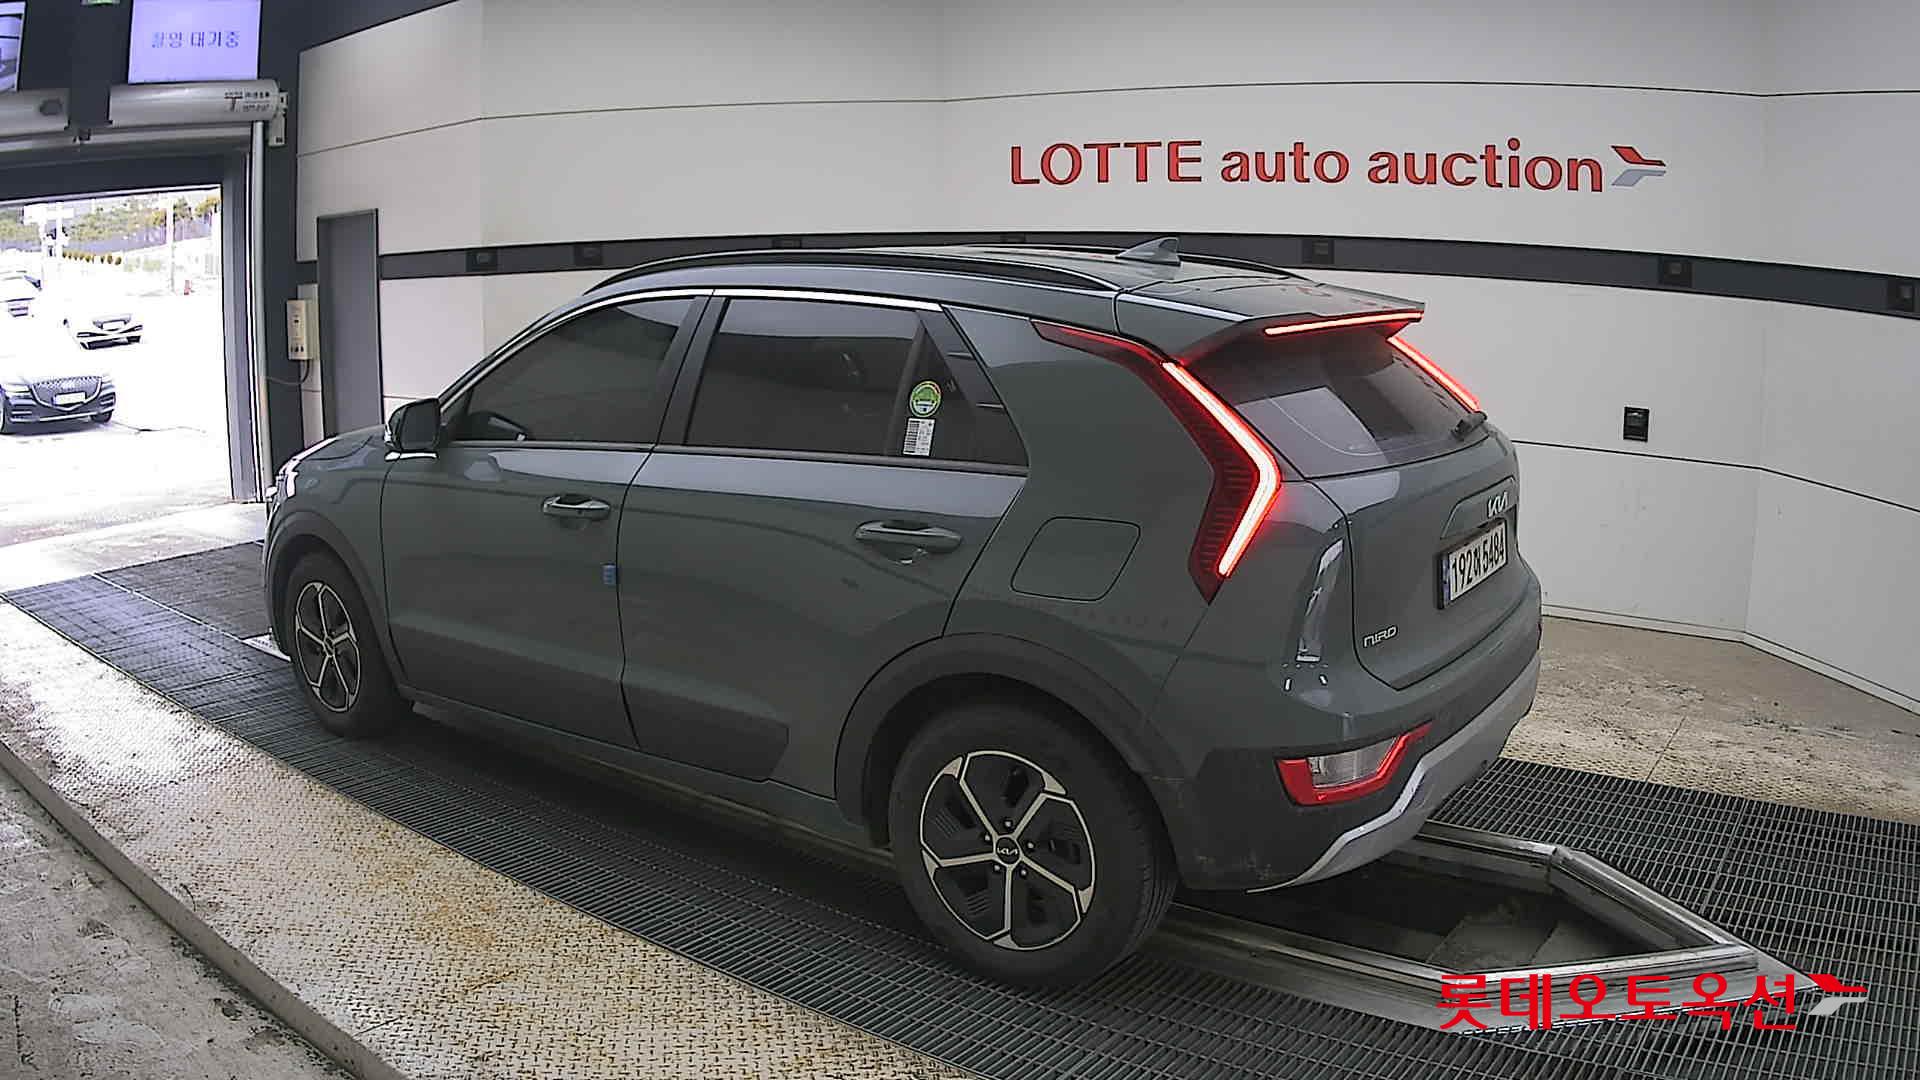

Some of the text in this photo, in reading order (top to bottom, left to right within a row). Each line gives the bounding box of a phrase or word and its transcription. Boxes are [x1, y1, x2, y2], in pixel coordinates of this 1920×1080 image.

[1010, 137, 1603, 193] LOTTE auto auction
